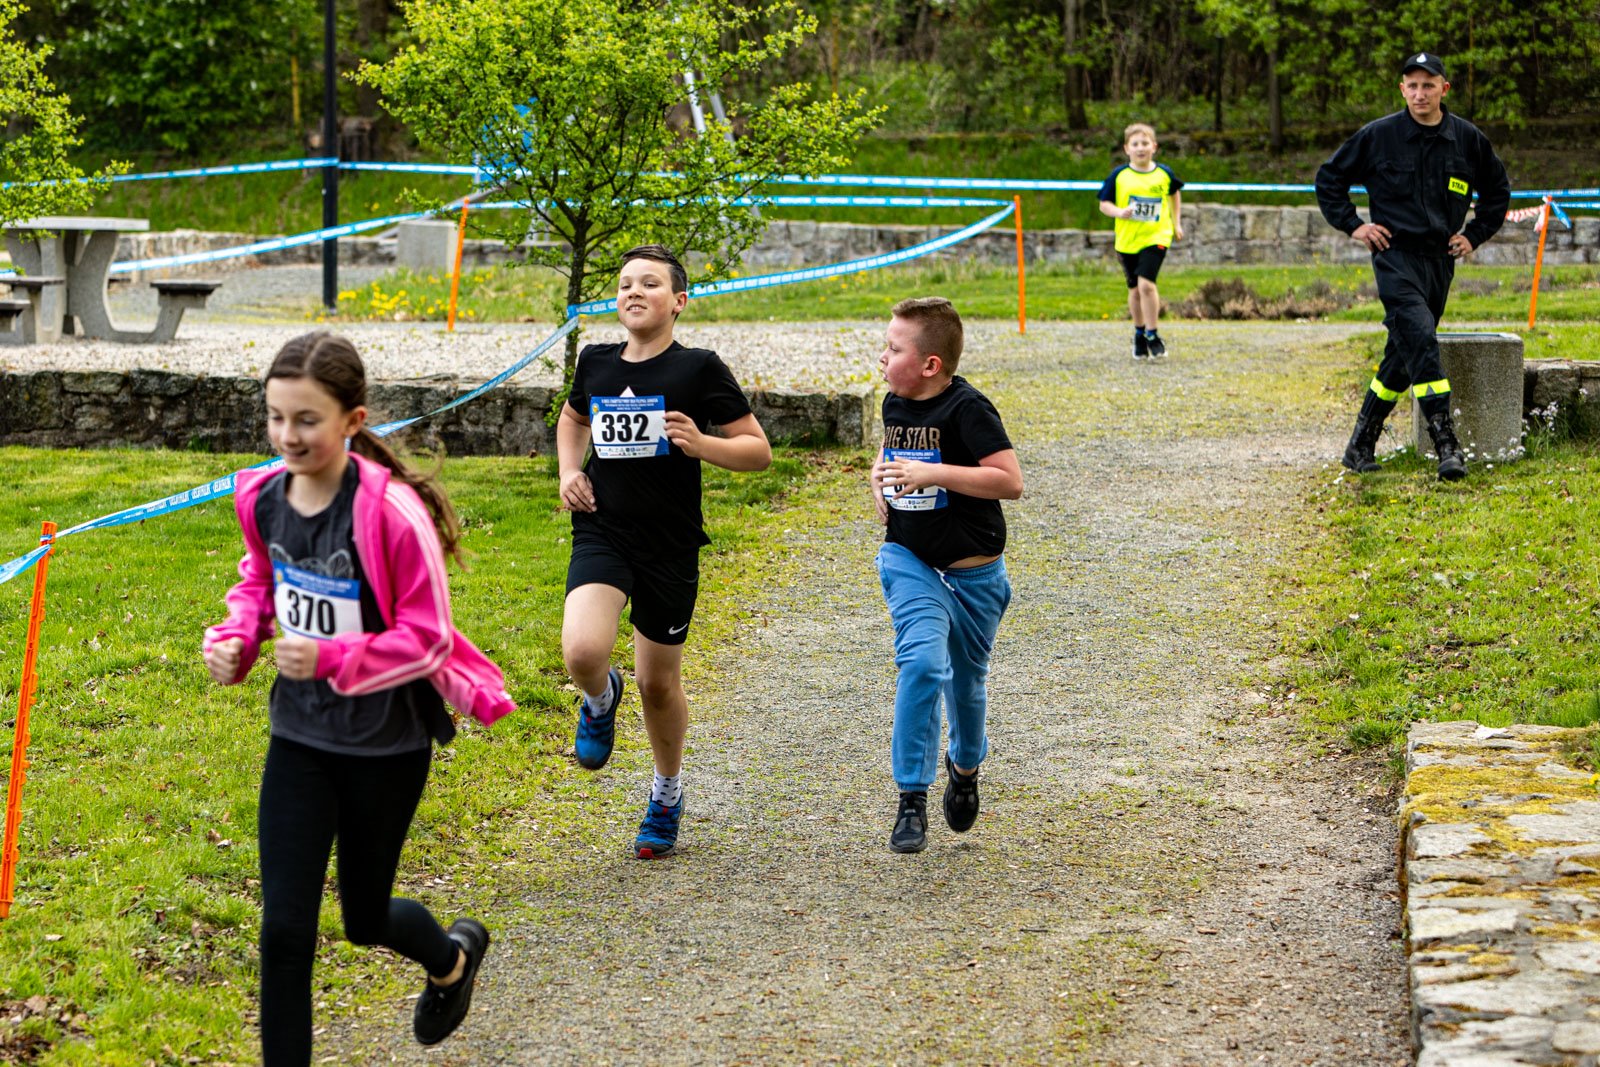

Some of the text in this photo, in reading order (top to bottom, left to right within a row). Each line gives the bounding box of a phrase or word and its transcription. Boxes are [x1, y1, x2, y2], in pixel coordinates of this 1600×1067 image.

[1135, 203, 1155, 217] 331
[601, 413, 650, 443] 332
[903, 426, 941, 452] STAR
[287, 589, 336, 636] 370
